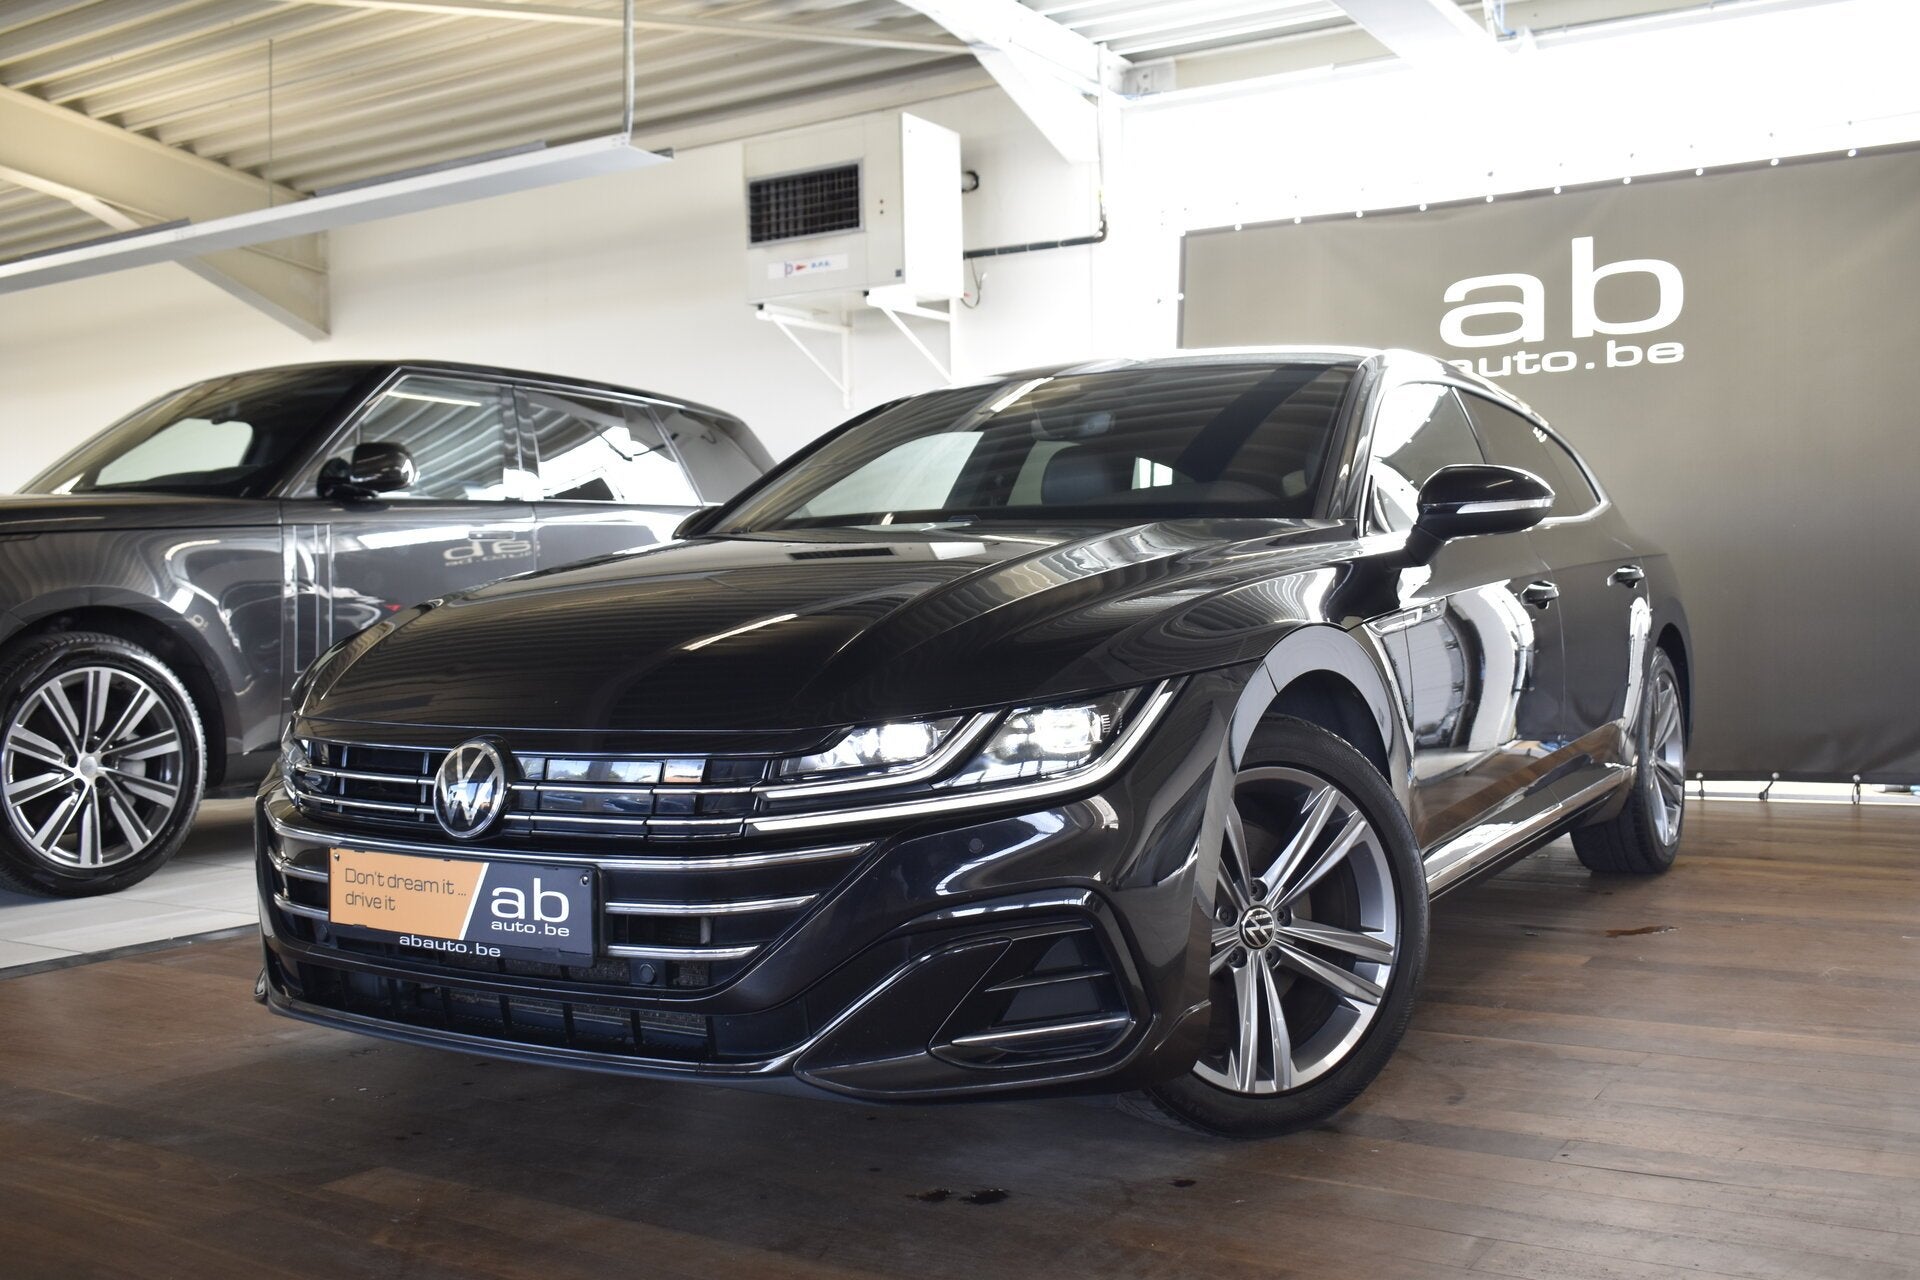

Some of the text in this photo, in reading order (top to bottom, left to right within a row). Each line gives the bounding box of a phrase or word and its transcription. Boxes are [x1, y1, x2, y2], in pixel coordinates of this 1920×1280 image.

[1439, 235, 1685, 349] ab
[344, 867, 386, 888] Don't
[386, 873, 440, 894] dream
[344, 890, 396, 911] drive it
[490, 877, 571, 923] ab
[490, 920, 571, 938] auto.be
[399, 934, 502, 958] abauto.be
